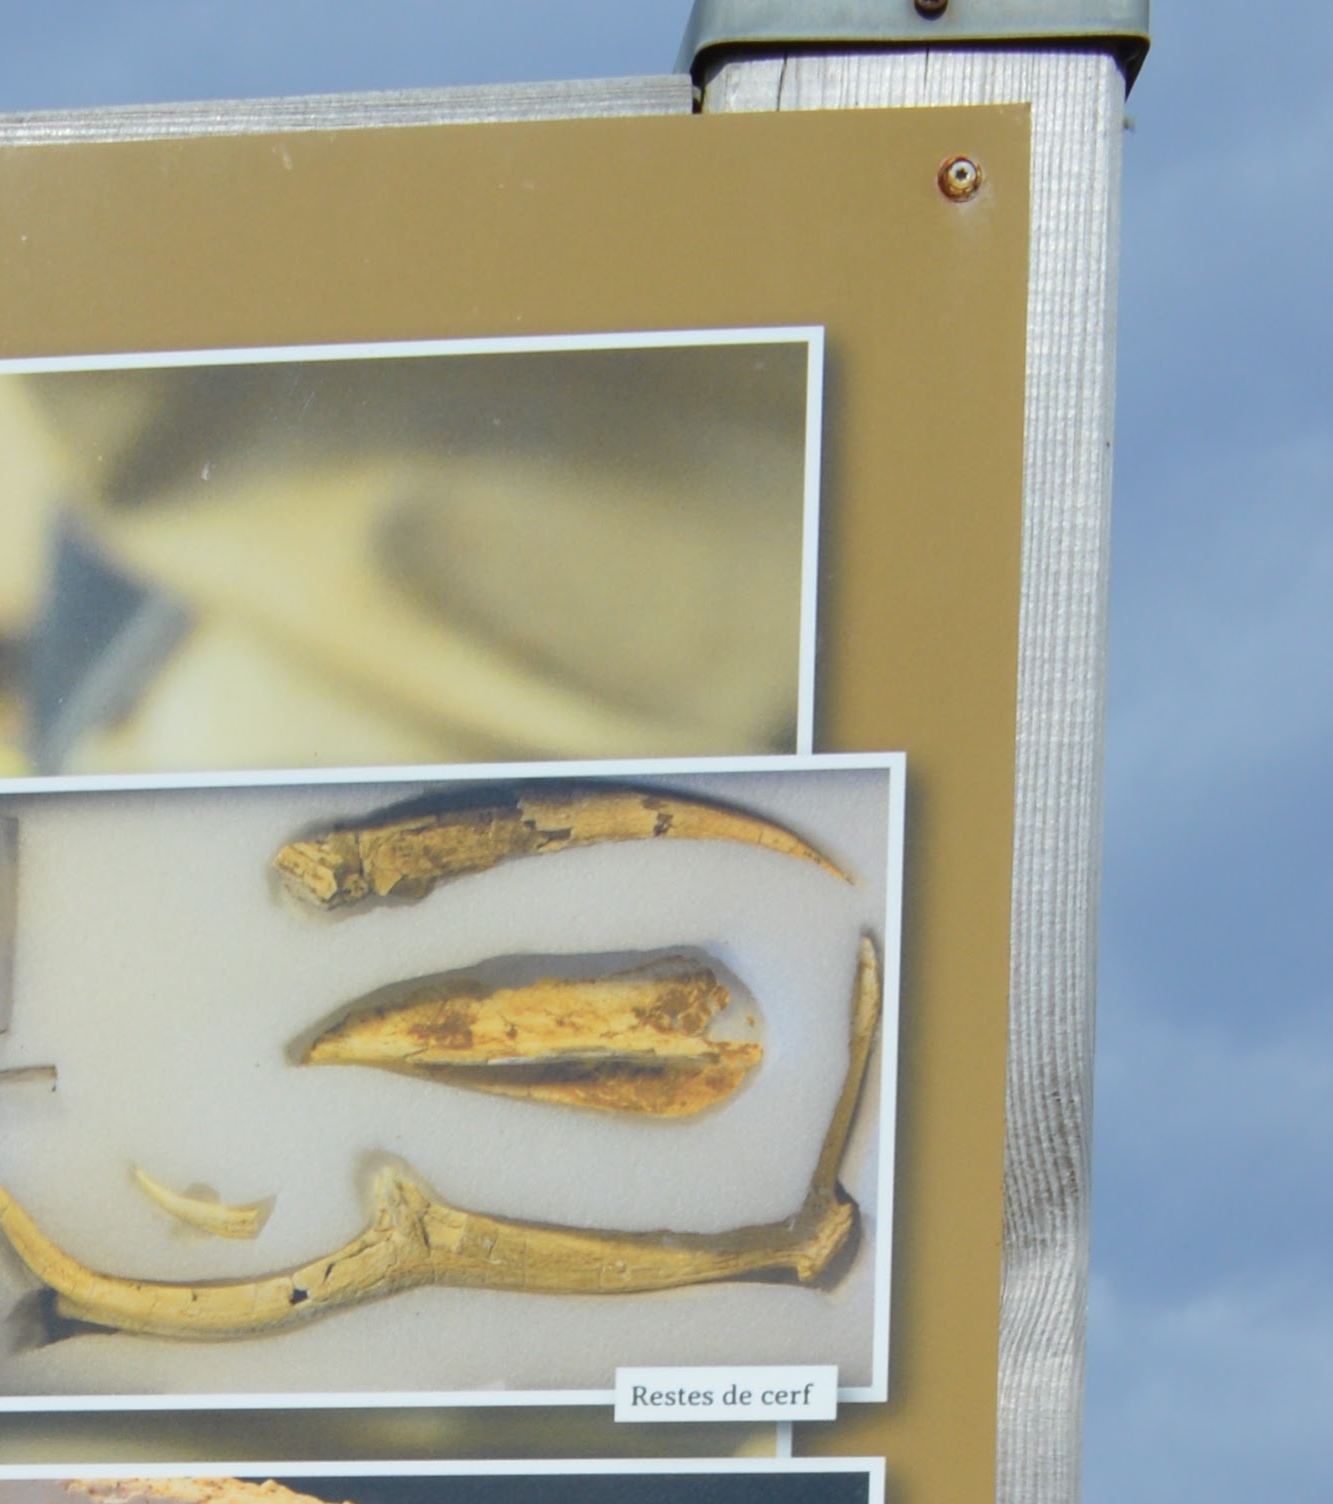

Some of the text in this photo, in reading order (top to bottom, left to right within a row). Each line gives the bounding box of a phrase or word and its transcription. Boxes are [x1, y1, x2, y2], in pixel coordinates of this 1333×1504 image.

[632, 1383, 813, 1406] Restes de cerf
